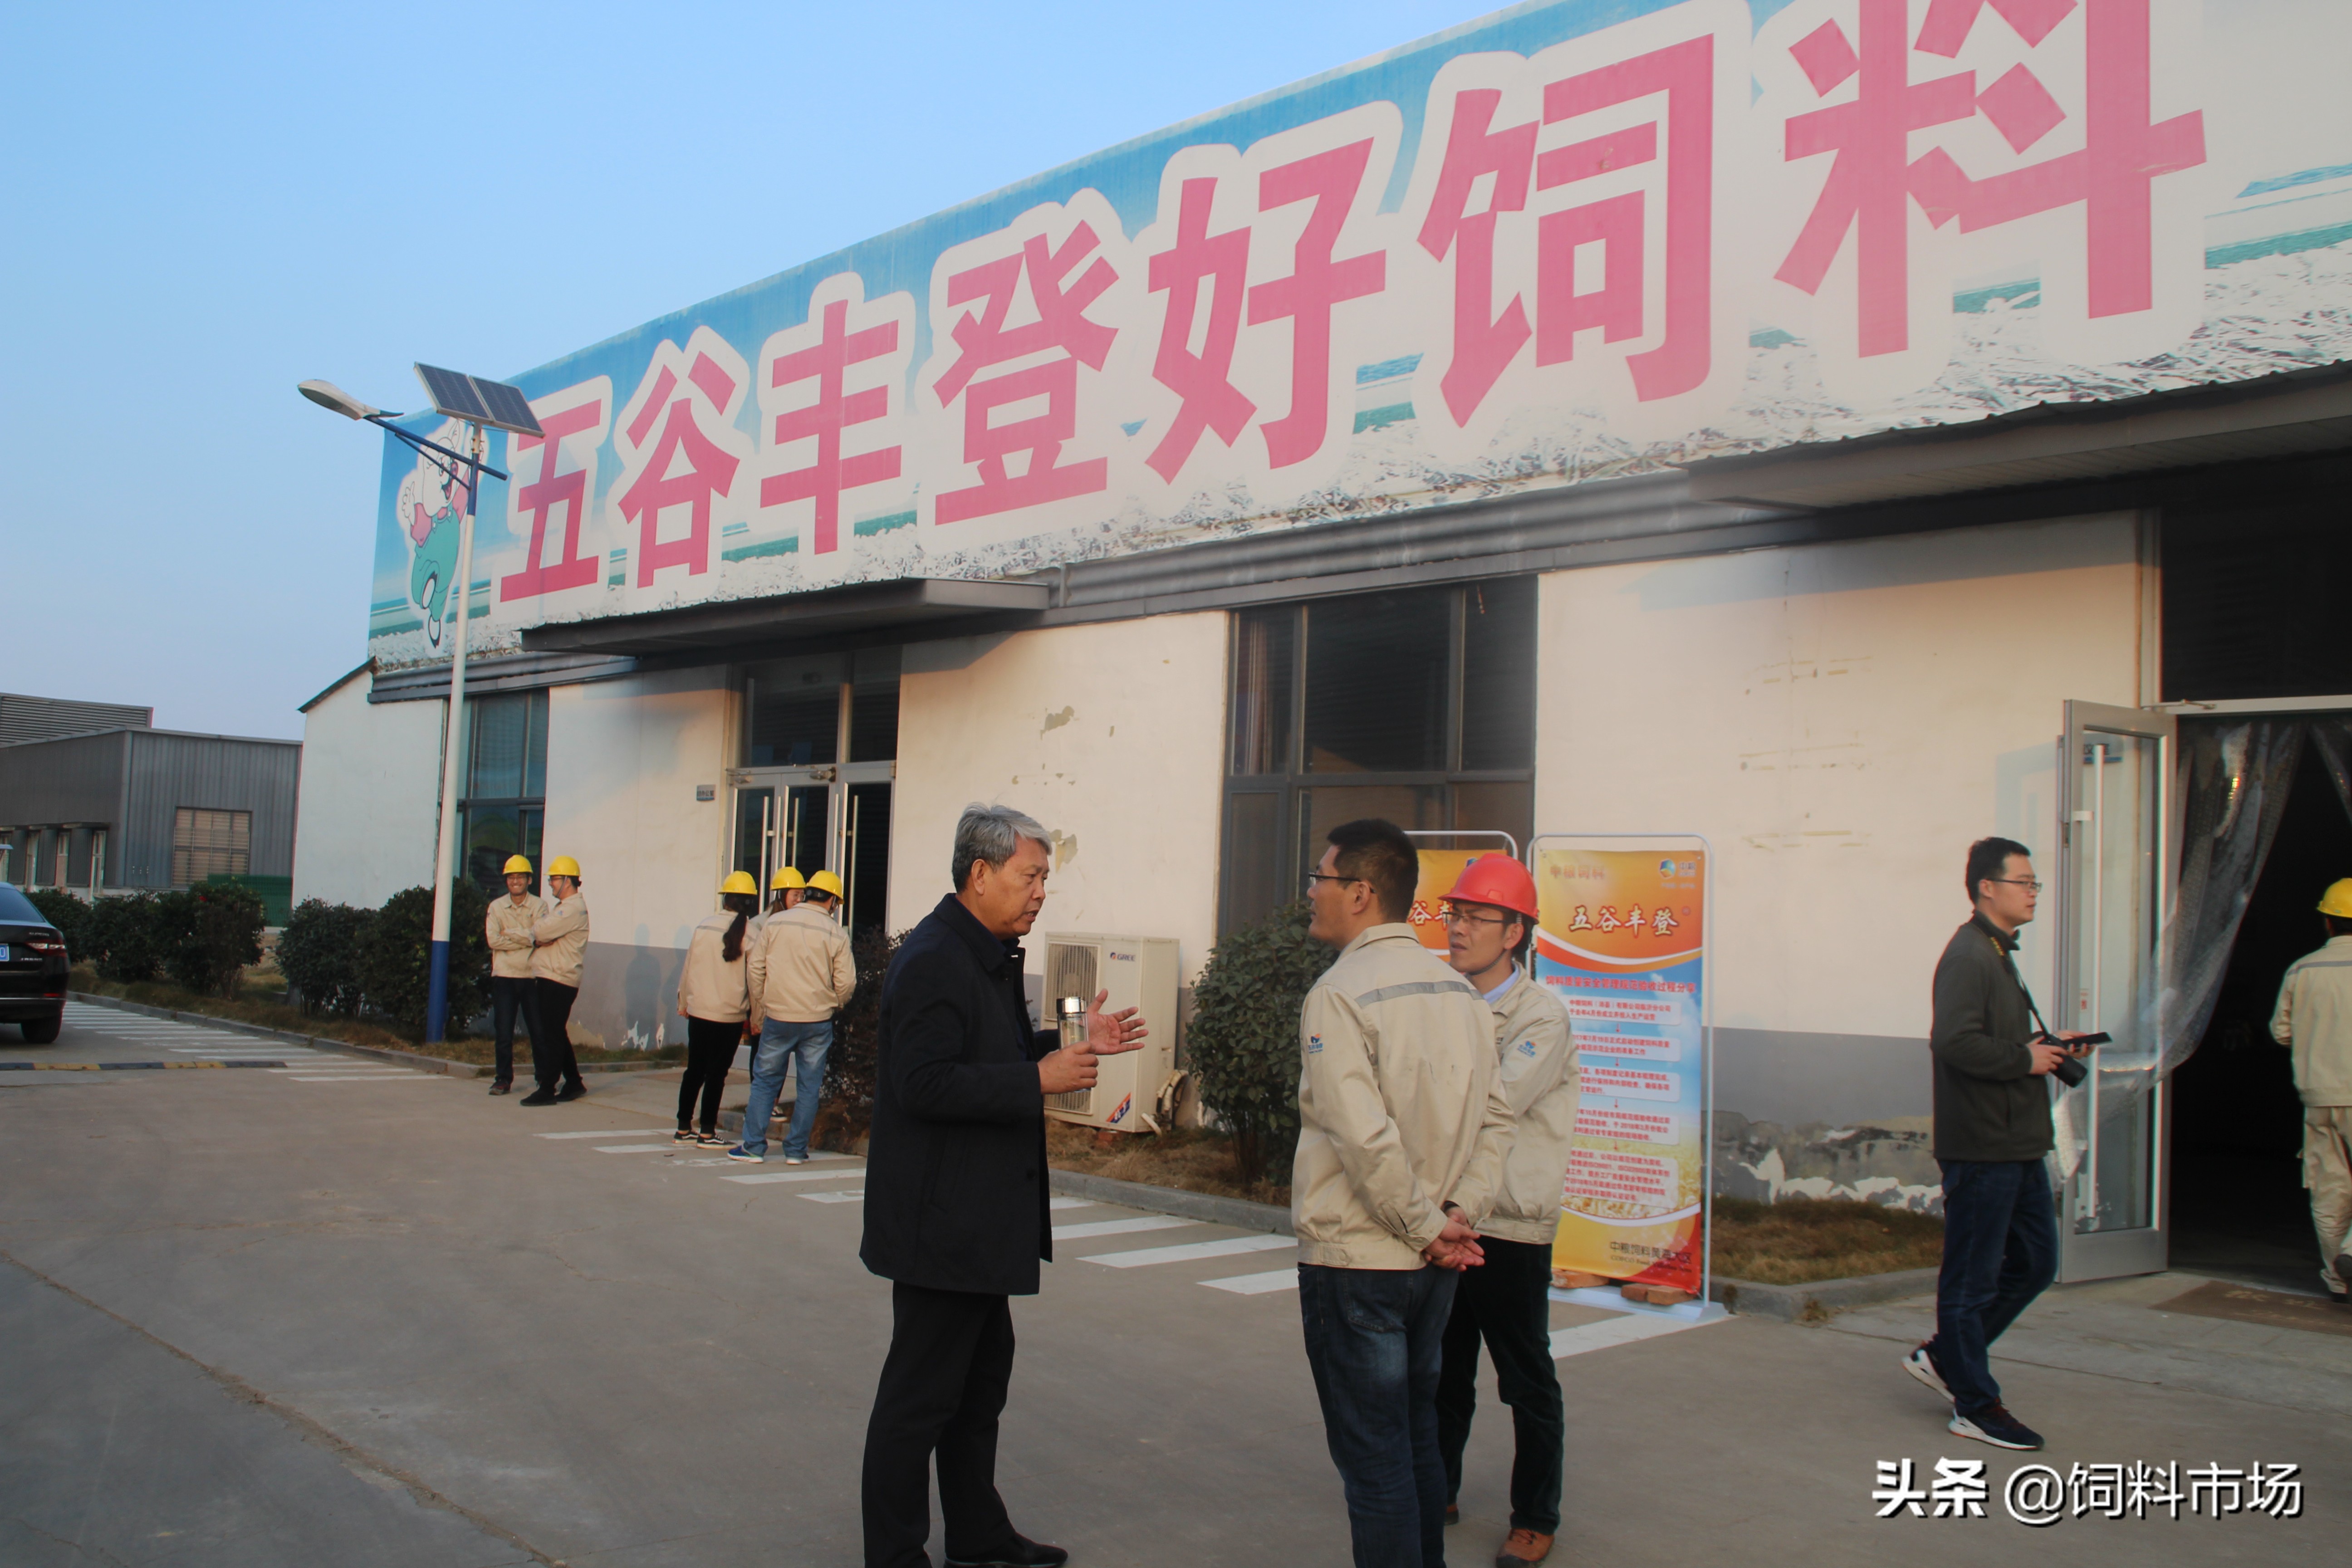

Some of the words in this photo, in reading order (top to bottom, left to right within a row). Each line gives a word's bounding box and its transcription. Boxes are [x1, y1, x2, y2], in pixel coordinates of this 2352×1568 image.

[500, 0, 2207, 602] 五谷丰登好饲料
[1549, 864, 1605, 879] 中粮饲料
[1568, 902, 1680, 938] 五谷丰登
[1117, 953, 1136, 962] GREE
[1545, 975, 1696, 994] 饲料质量安全管理规范验收过程分享
[1610, 1240, 1692, 1264] 中粮饲料黄海大区
